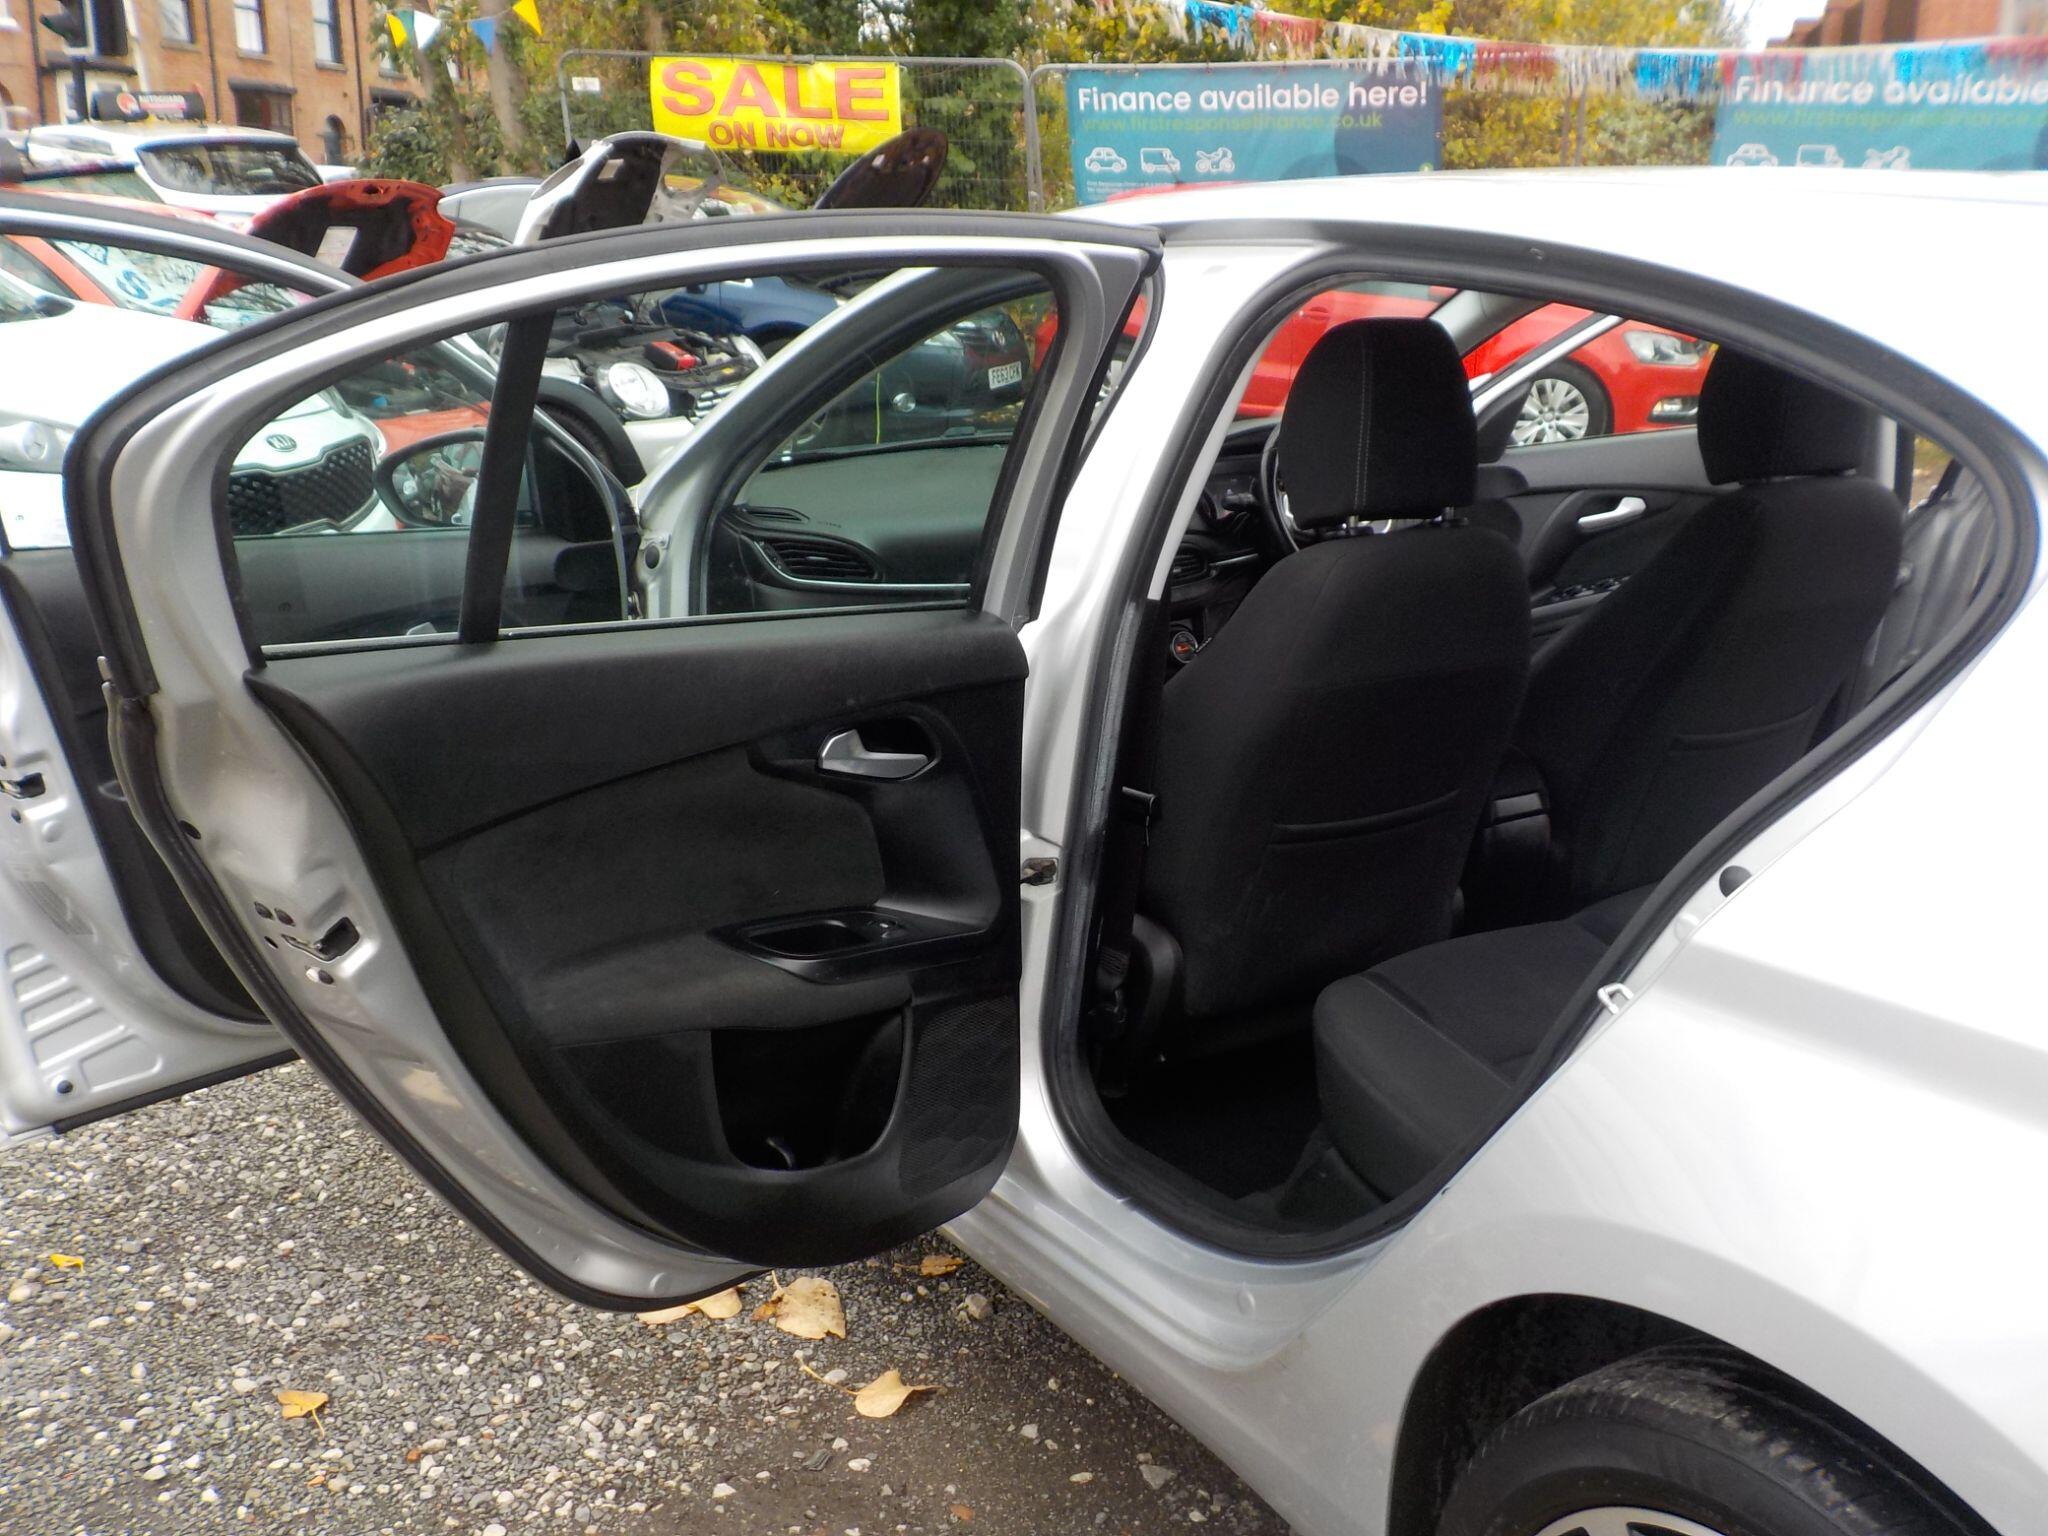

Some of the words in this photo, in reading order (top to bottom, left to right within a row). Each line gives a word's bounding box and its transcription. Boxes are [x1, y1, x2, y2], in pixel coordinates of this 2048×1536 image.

[661, 61, 889, 121] SALE
[1078, 86, 1191, 112] Finance
[1199, 82, 1340, 111] available
[1348, 80, 1428, 108] here!
[1735, 74, 1875, 104] Finance
[708, 120, 757, 148] ON
[766, 122, 845, 149] NOW
[1082, 111, 1384, 133] www.firstresponsefinance.co.uk
